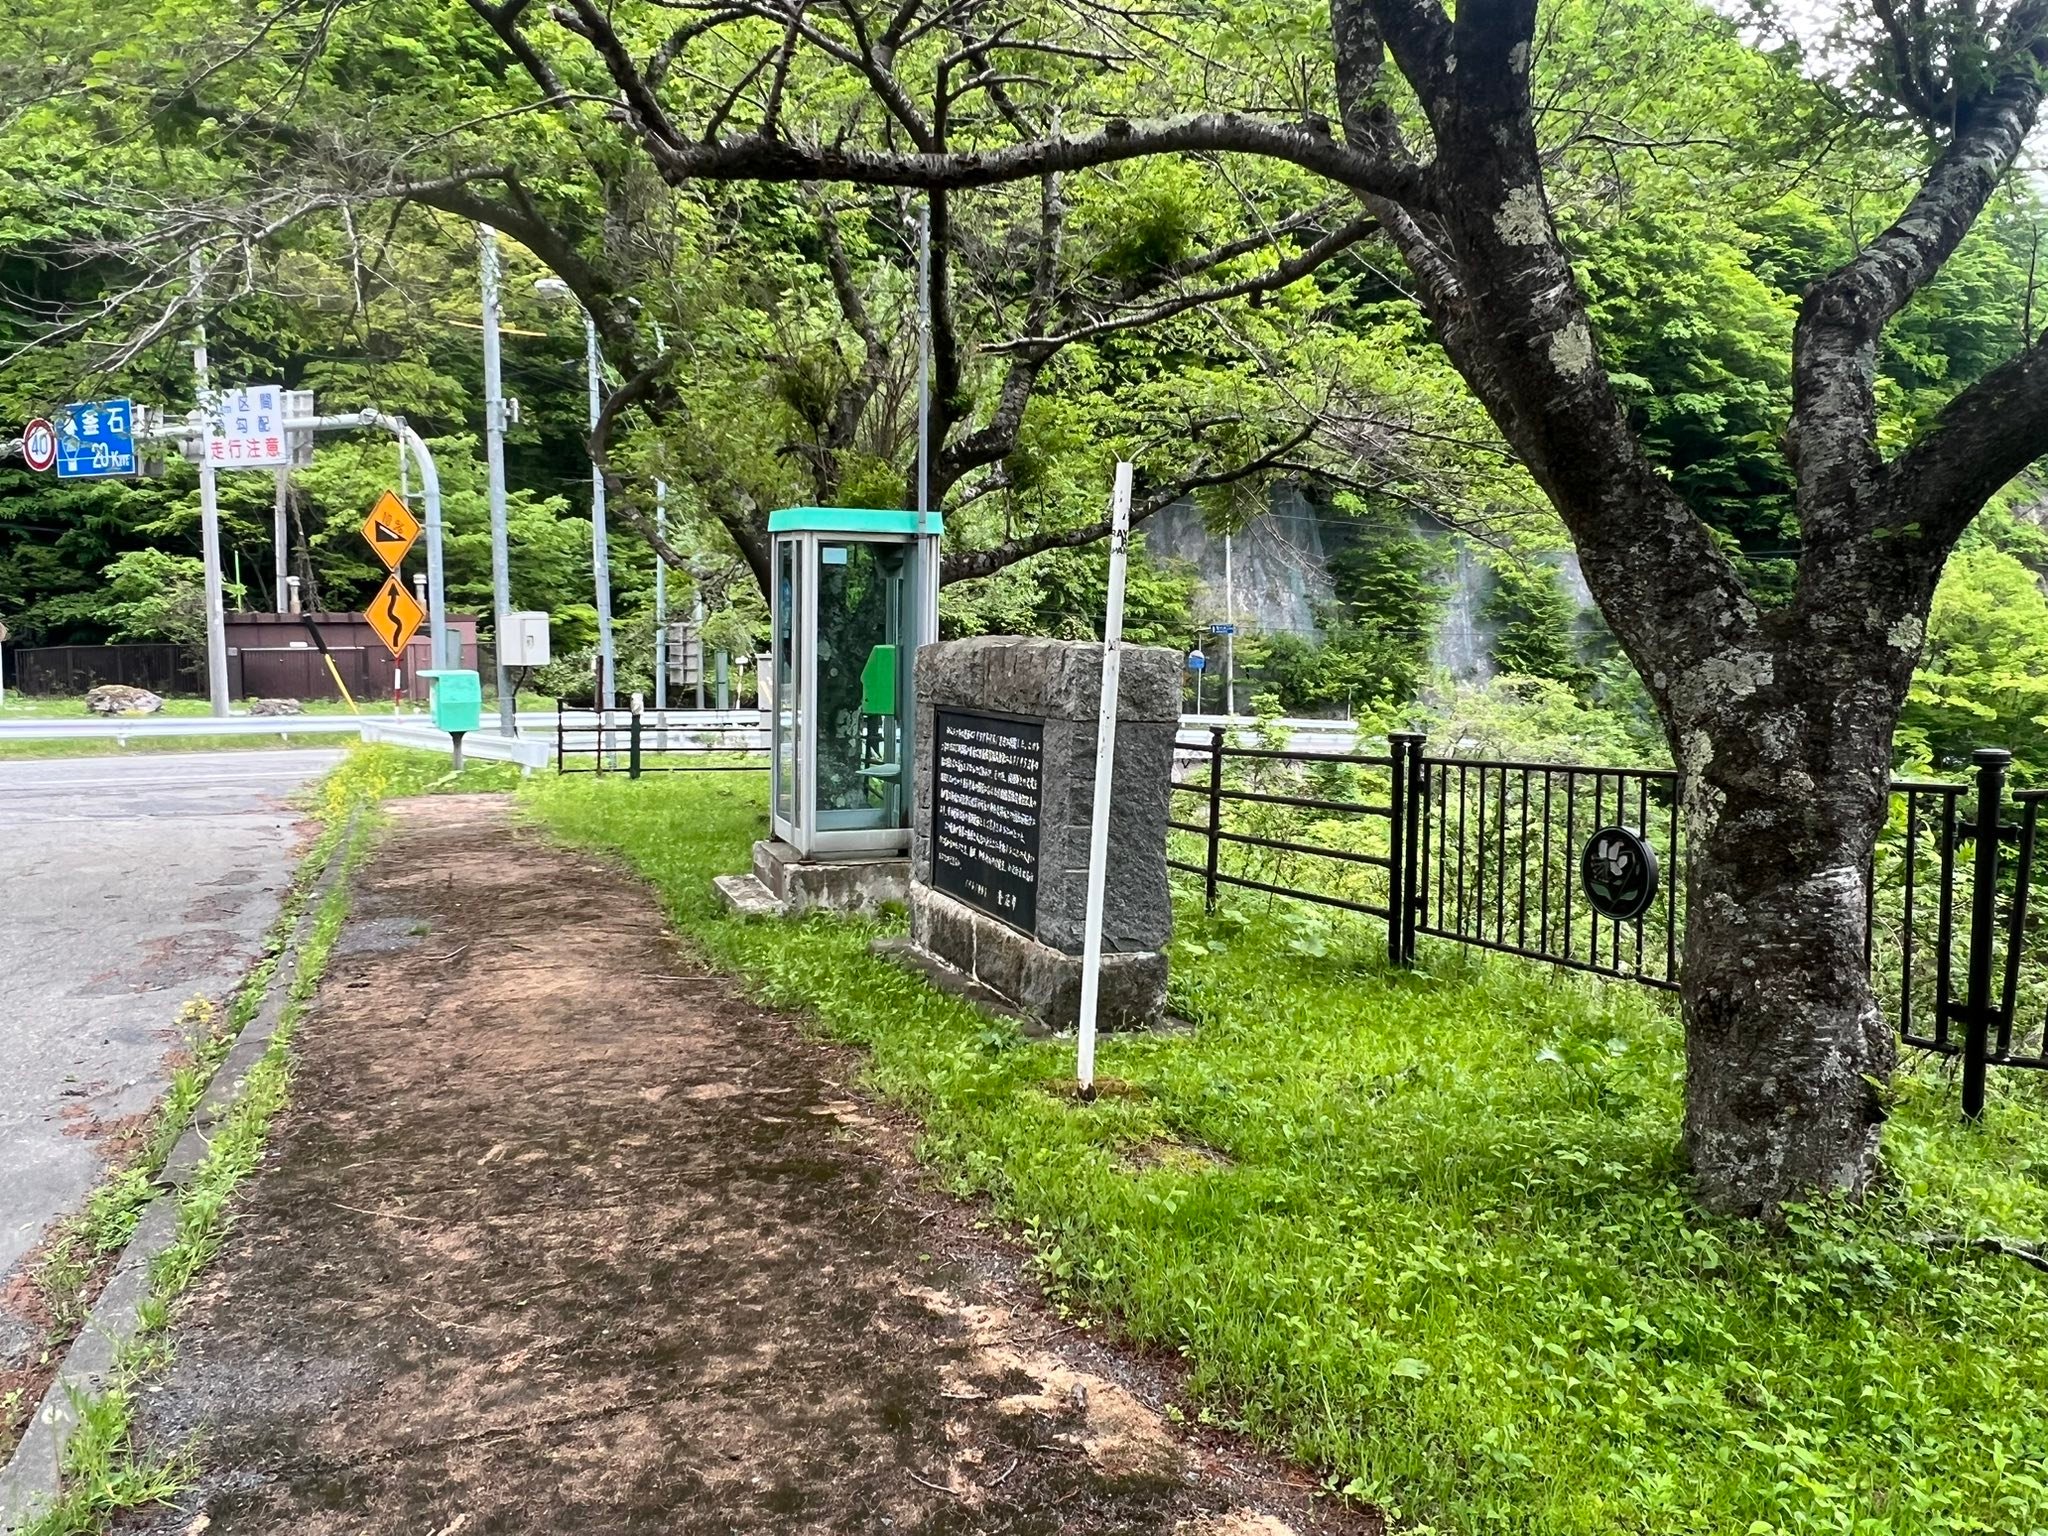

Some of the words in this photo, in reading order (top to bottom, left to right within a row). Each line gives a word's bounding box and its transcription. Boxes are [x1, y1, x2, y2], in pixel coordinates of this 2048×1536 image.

[31, 433, 49, 456] 40
[210, 437, 280, 460] 走行注意
